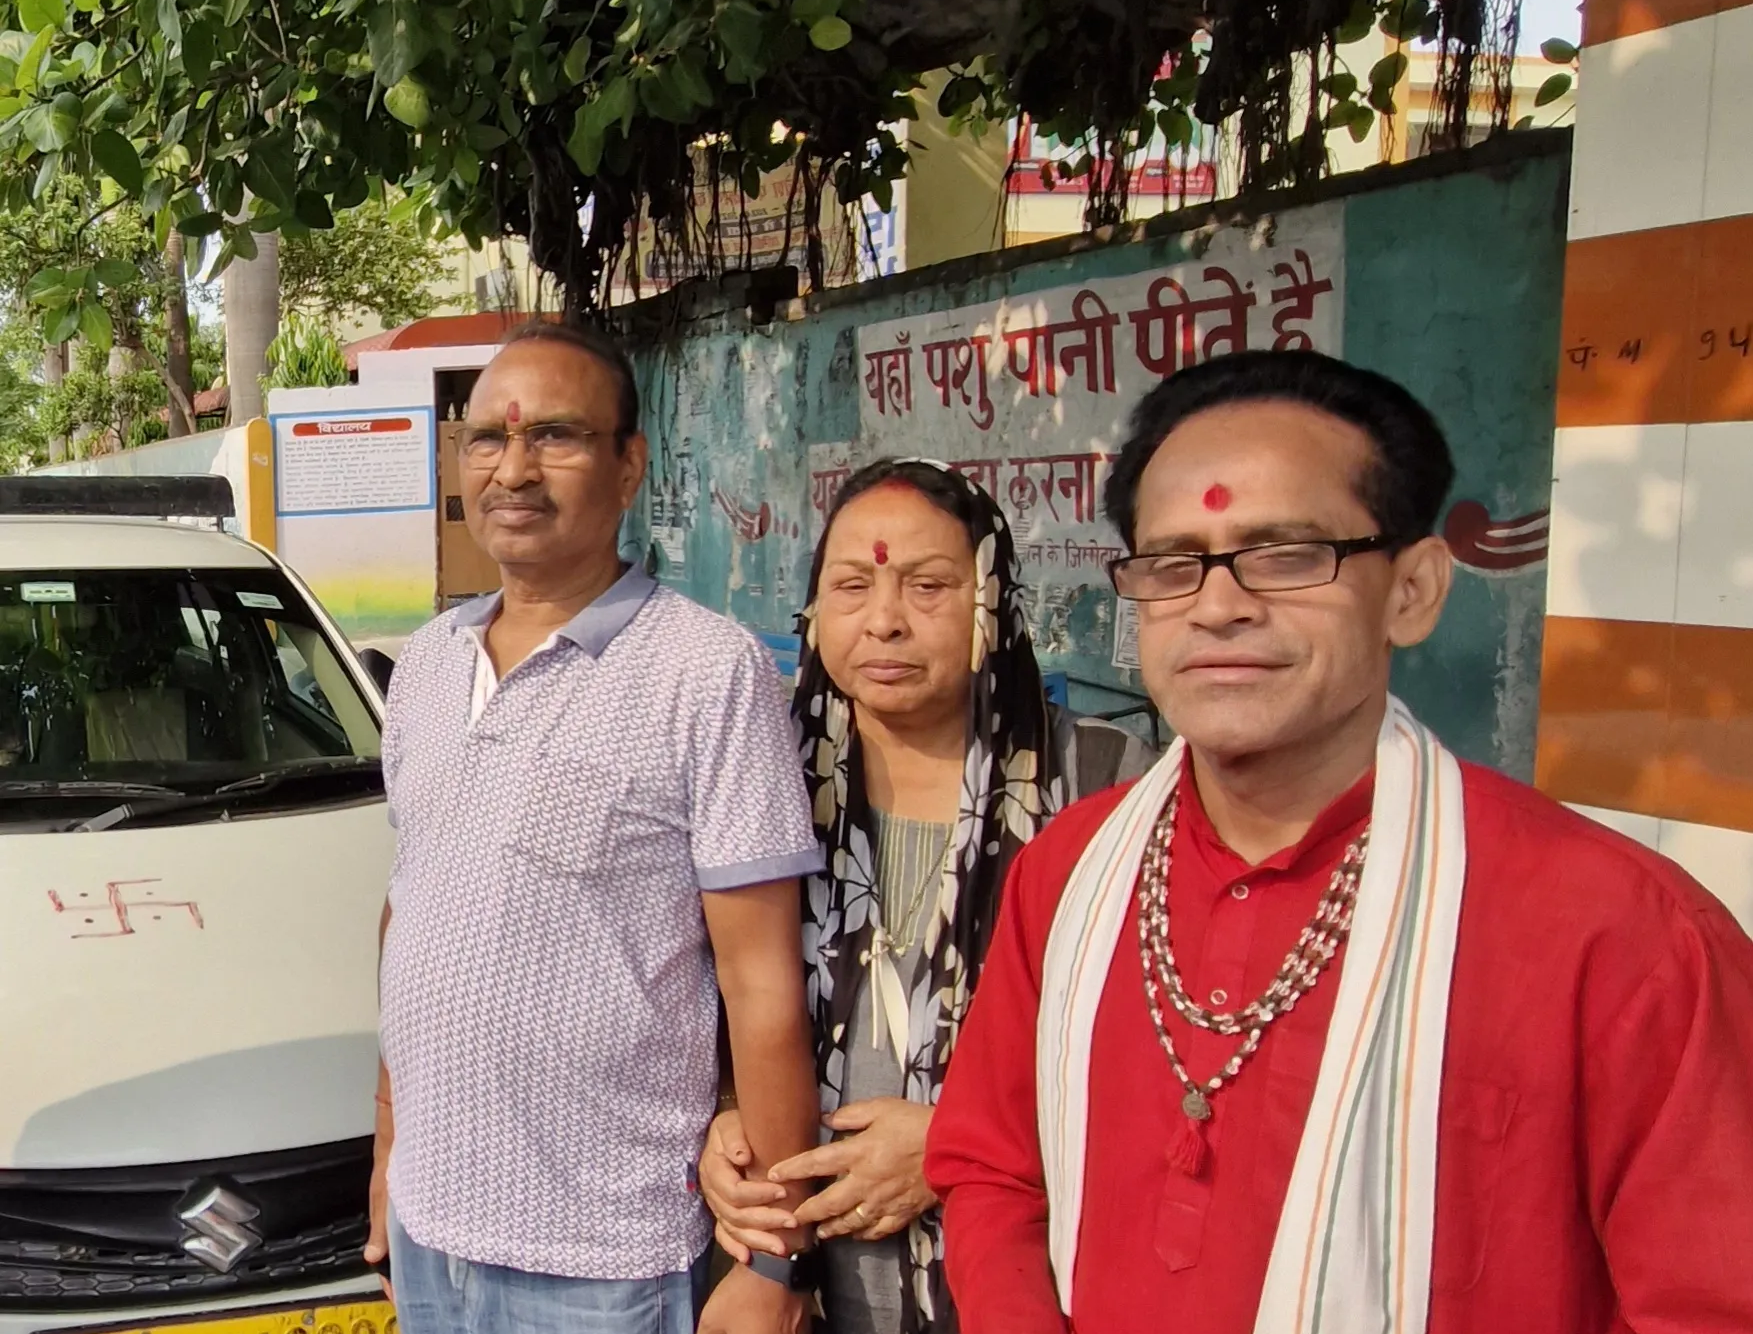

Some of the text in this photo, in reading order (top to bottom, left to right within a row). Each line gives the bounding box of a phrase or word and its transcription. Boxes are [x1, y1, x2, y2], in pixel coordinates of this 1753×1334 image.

[864, 331, 913, 416] यहाँ
[921, 334, 993, 431] पशु
[1003, 288, 1121, 399] पानी
[1271, 248, 1334, 352] है
[317, 421, 372, 434] विद्यालय
